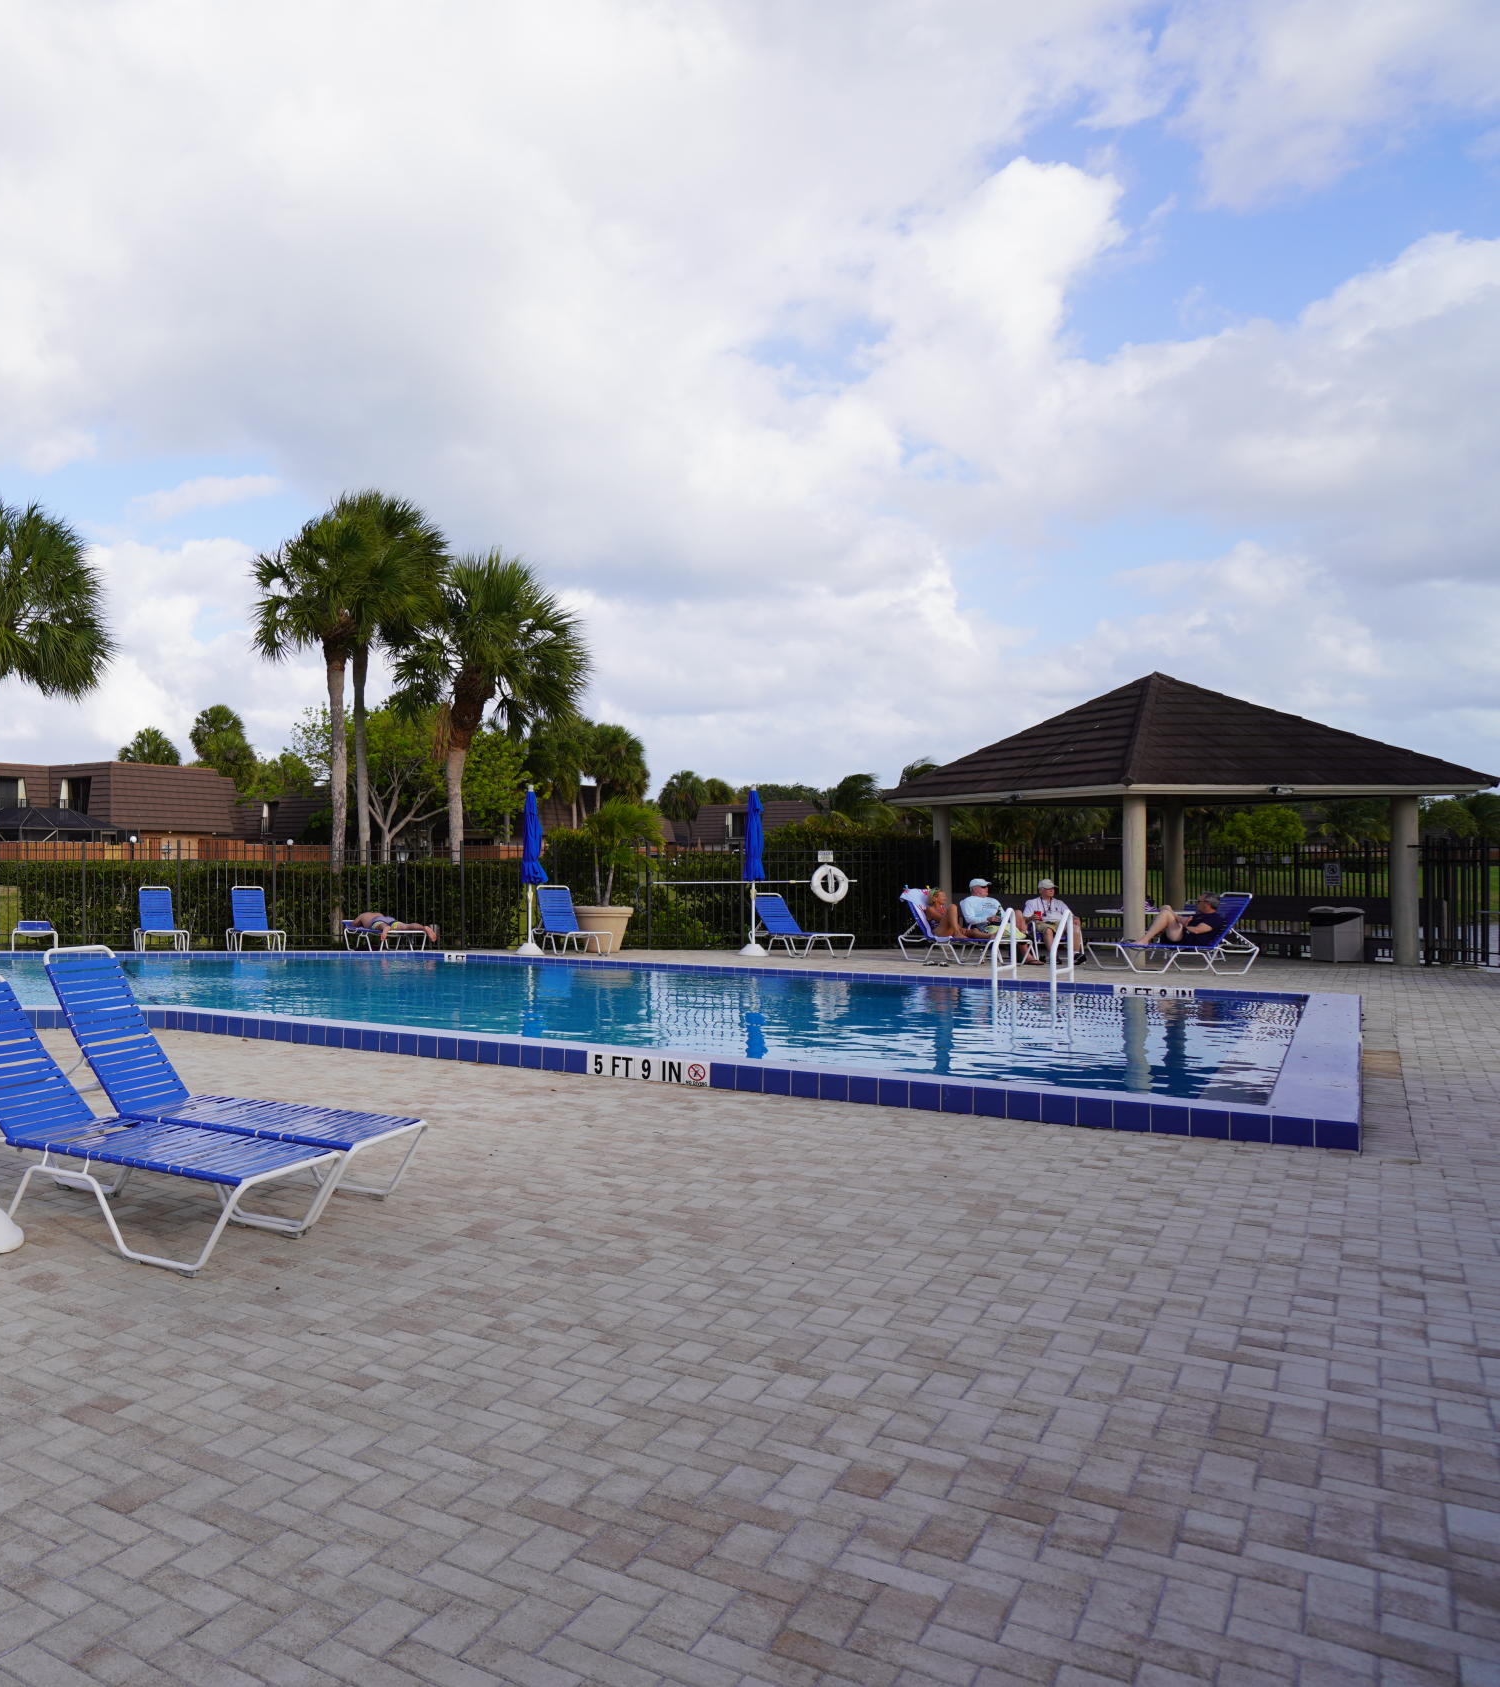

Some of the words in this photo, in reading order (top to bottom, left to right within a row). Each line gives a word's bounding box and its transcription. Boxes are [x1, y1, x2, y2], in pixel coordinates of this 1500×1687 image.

[594, 1054, 603, 1075] 5
[611, 1055, 633, 1078] FT
[641, 1058, 651, 1080] 9
[661, 1060, 682, 1083] IN
